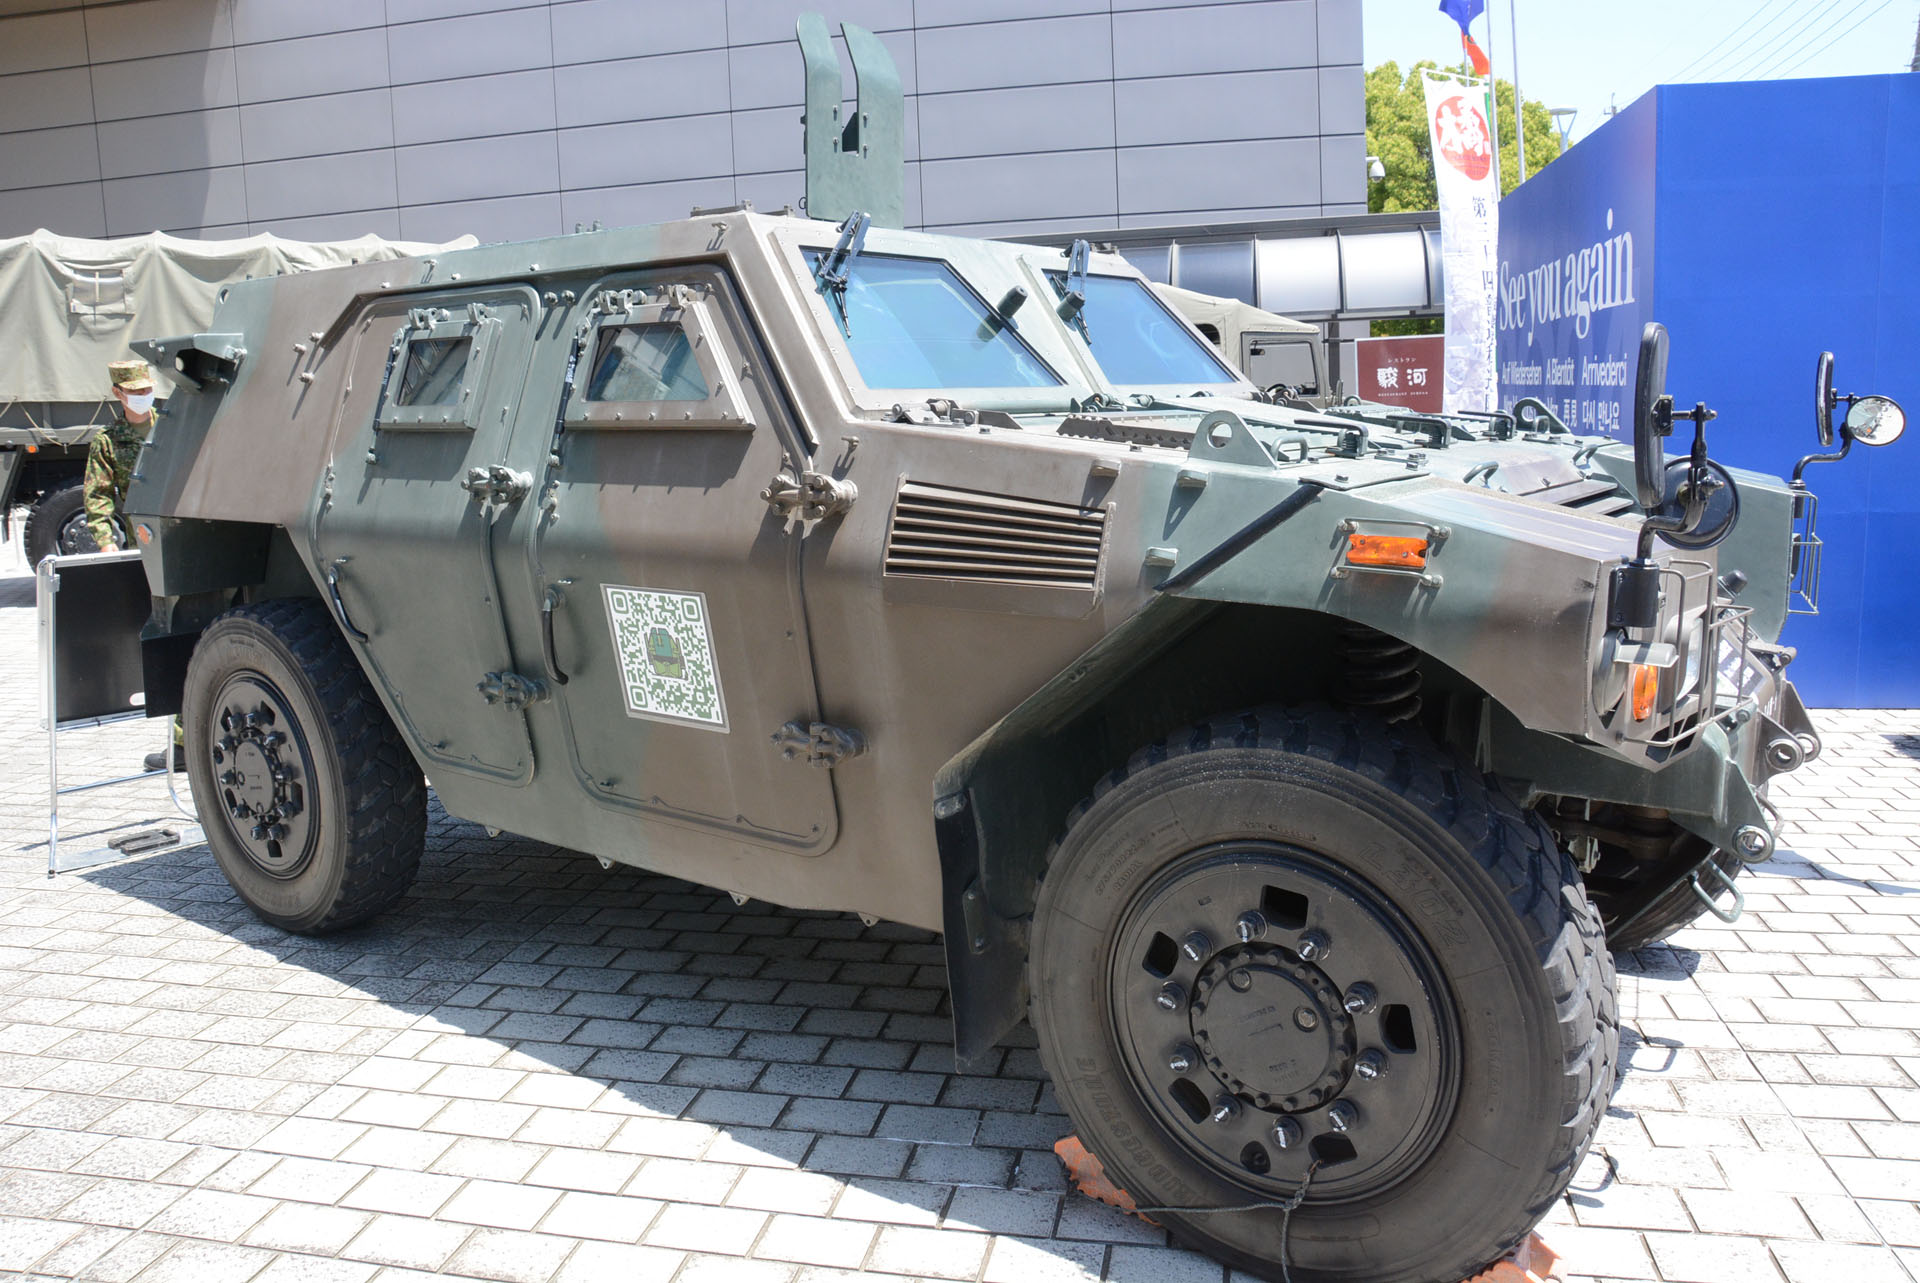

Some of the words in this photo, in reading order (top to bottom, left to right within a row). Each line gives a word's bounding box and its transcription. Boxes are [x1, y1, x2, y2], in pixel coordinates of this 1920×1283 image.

[1500, 261, 1526, 331] See
[1527, 259, 1561, 347] you
[1564, 208, 1635, 339] again
[1377, 366, 1428, 389] 駿河
[1510, 360, 1542, 385] Wiedersehen
[1581, 353, 1628, 386] Arrivederci
[1563, 399, 1578, 428] 再見
[1582, 400, 1596, 431] 다시
[1597, 401, 1620, 432] 만나요
